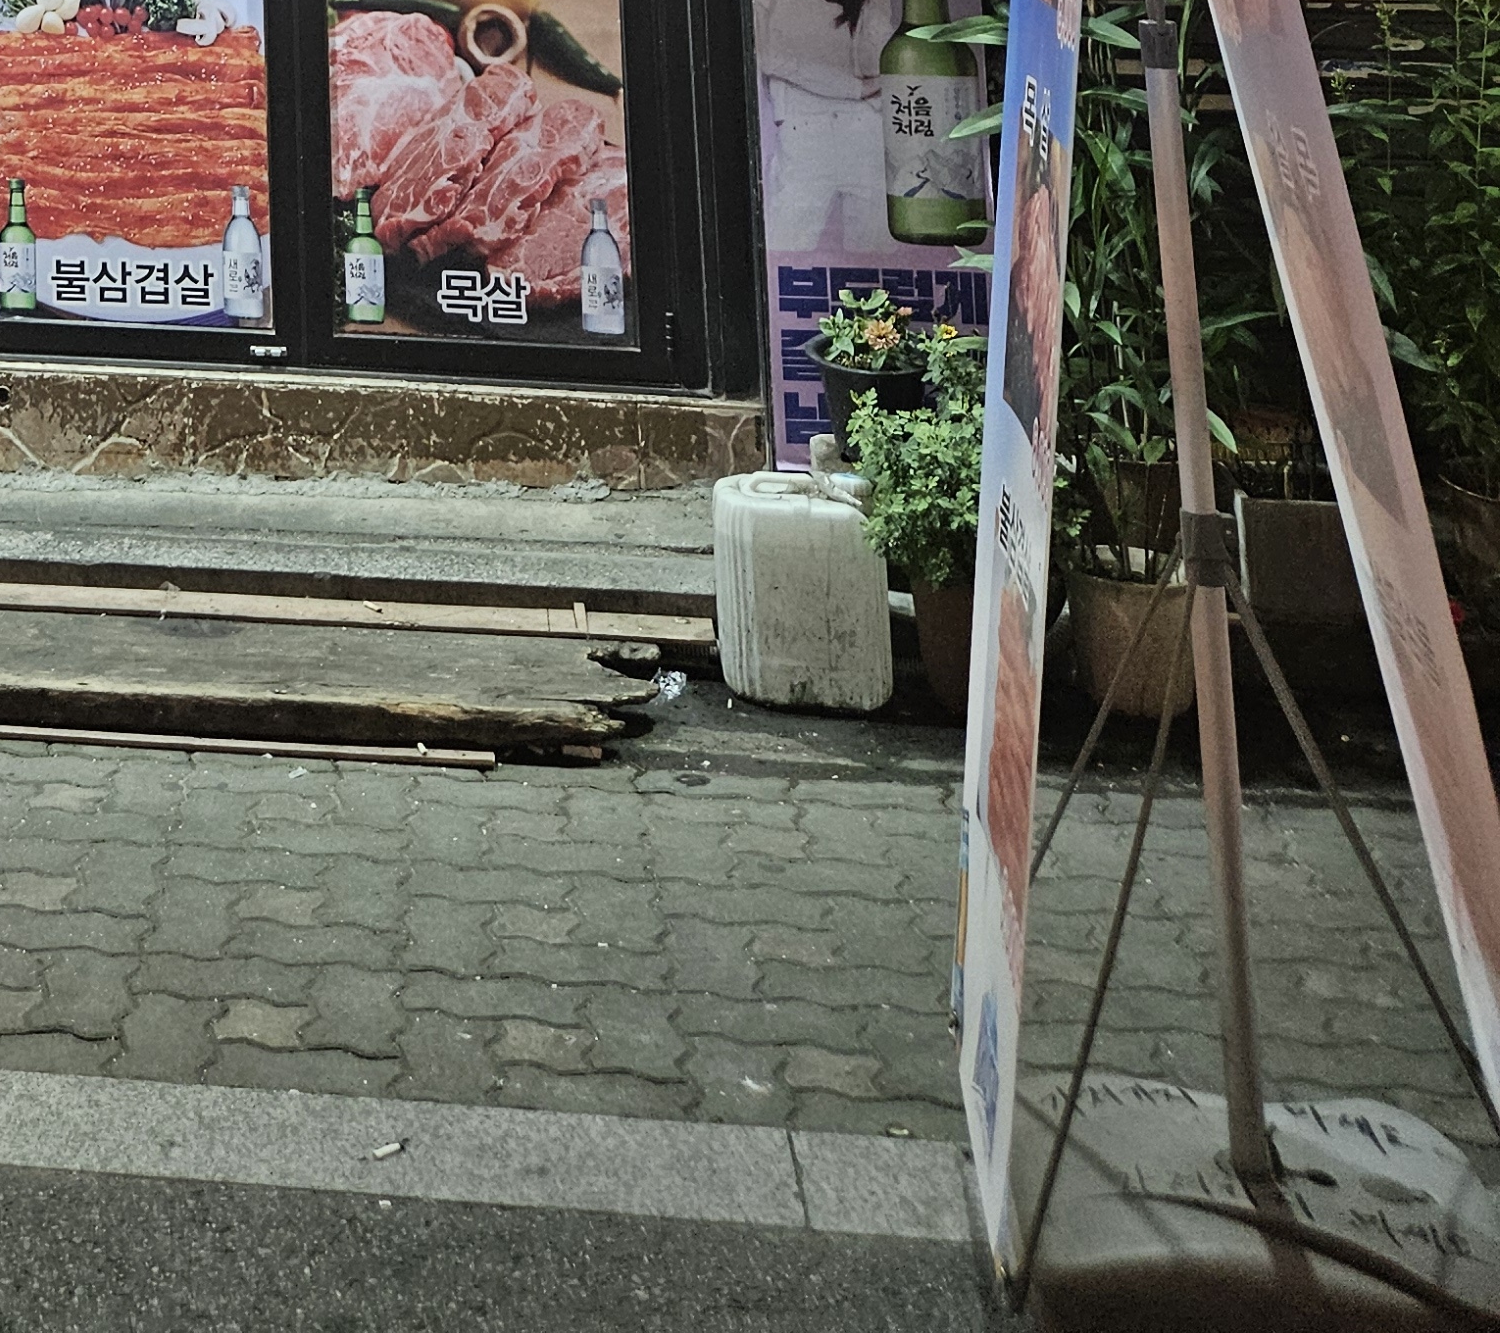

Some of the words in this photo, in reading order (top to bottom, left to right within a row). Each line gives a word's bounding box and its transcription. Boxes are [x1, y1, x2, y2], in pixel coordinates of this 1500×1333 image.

[890, 94, 933, 117] 처음
[891, 116, 935, 137] 처럼
[50, 258, 215, 307] 불삼겹살
[440, 273, 528, 320] 목살
